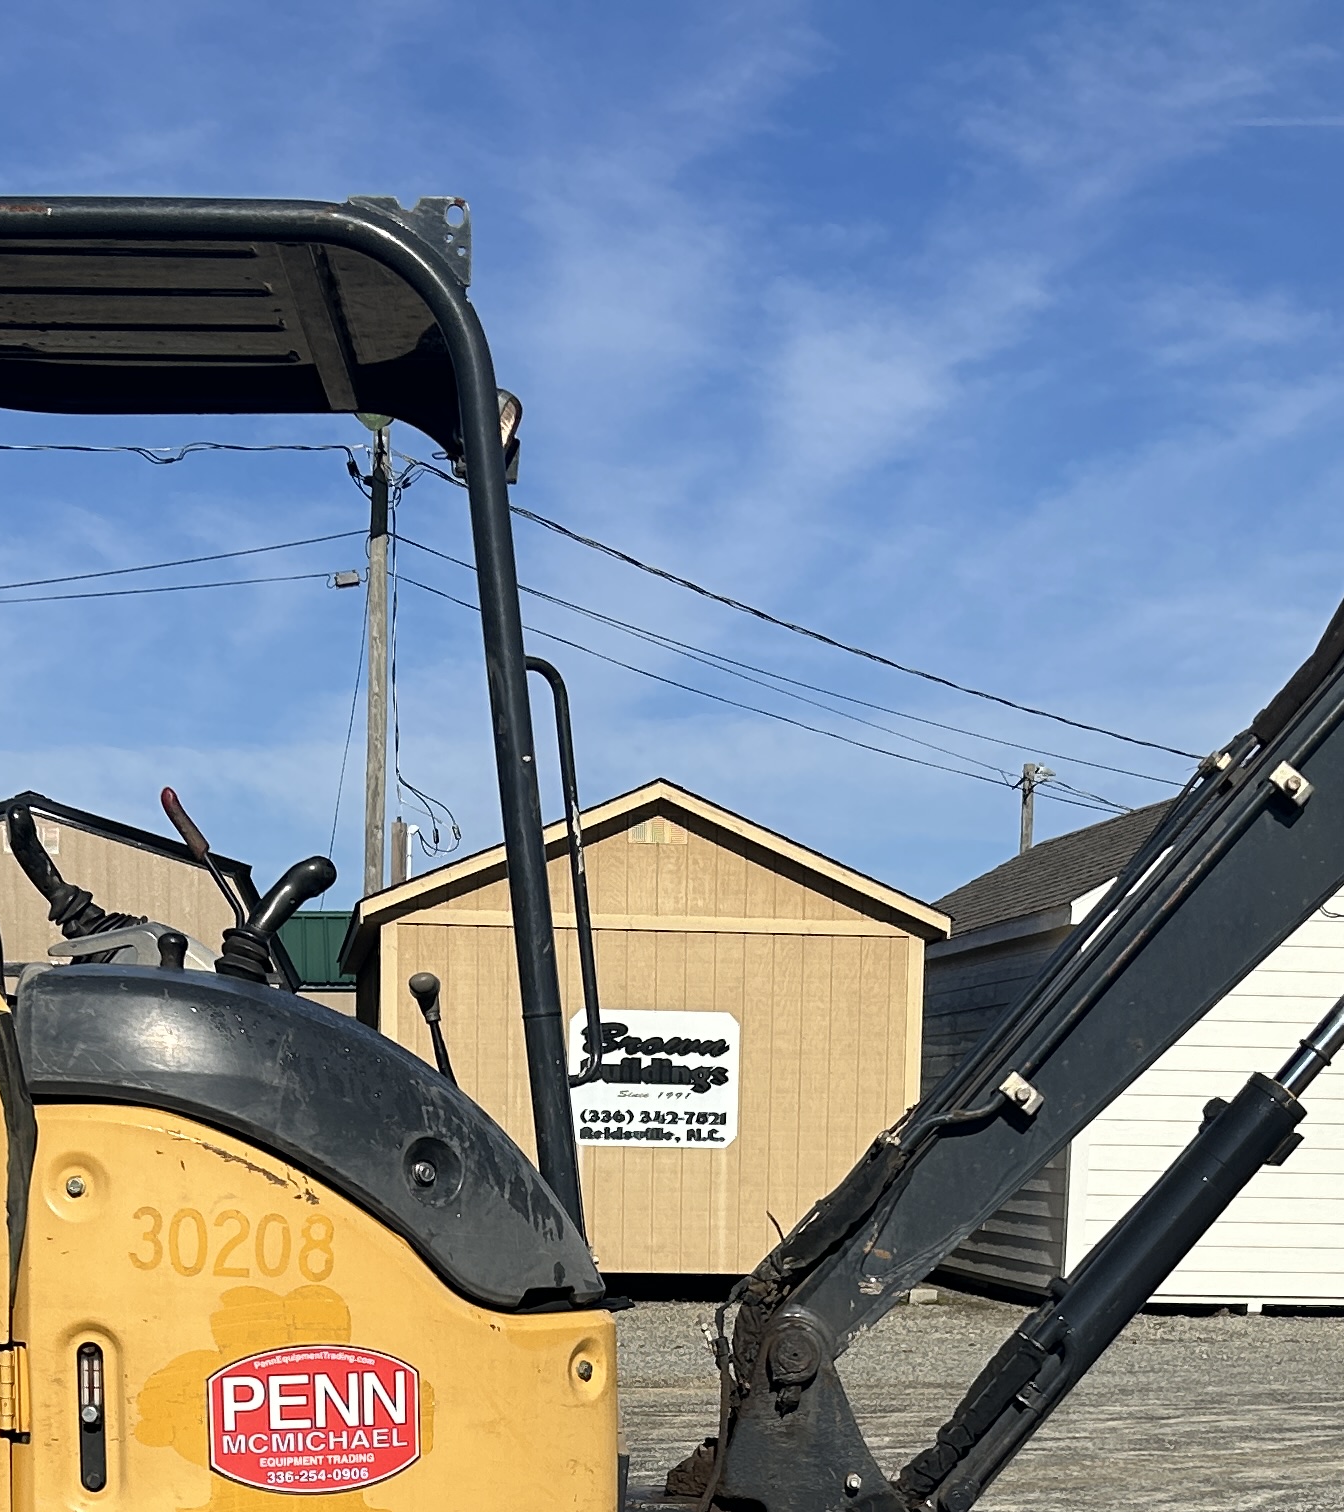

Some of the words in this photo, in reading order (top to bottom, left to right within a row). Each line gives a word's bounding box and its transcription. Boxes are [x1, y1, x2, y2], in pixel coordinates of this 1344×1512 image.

[580, 1021, 730, 1057] Brown
[616, 1089, 650, 1099] Since
[579, 1109, 635, 1125] (336)
[686, 1128, 726, 1142] N.C.
[128, 1206, 336, 1282] 30208
[253, 1351, 376, 1370] PennEquipmentTrading.com
[221, 1369, 407, 1432] PENN
[221, 1428, 408, 1455] MCMICHAEL
[259, 1455, 325, 1468] EQUIPMENT
[326, 1454, 375, 1466] TRADING
[266, 1467, 369, 1484] 336-254-0906
